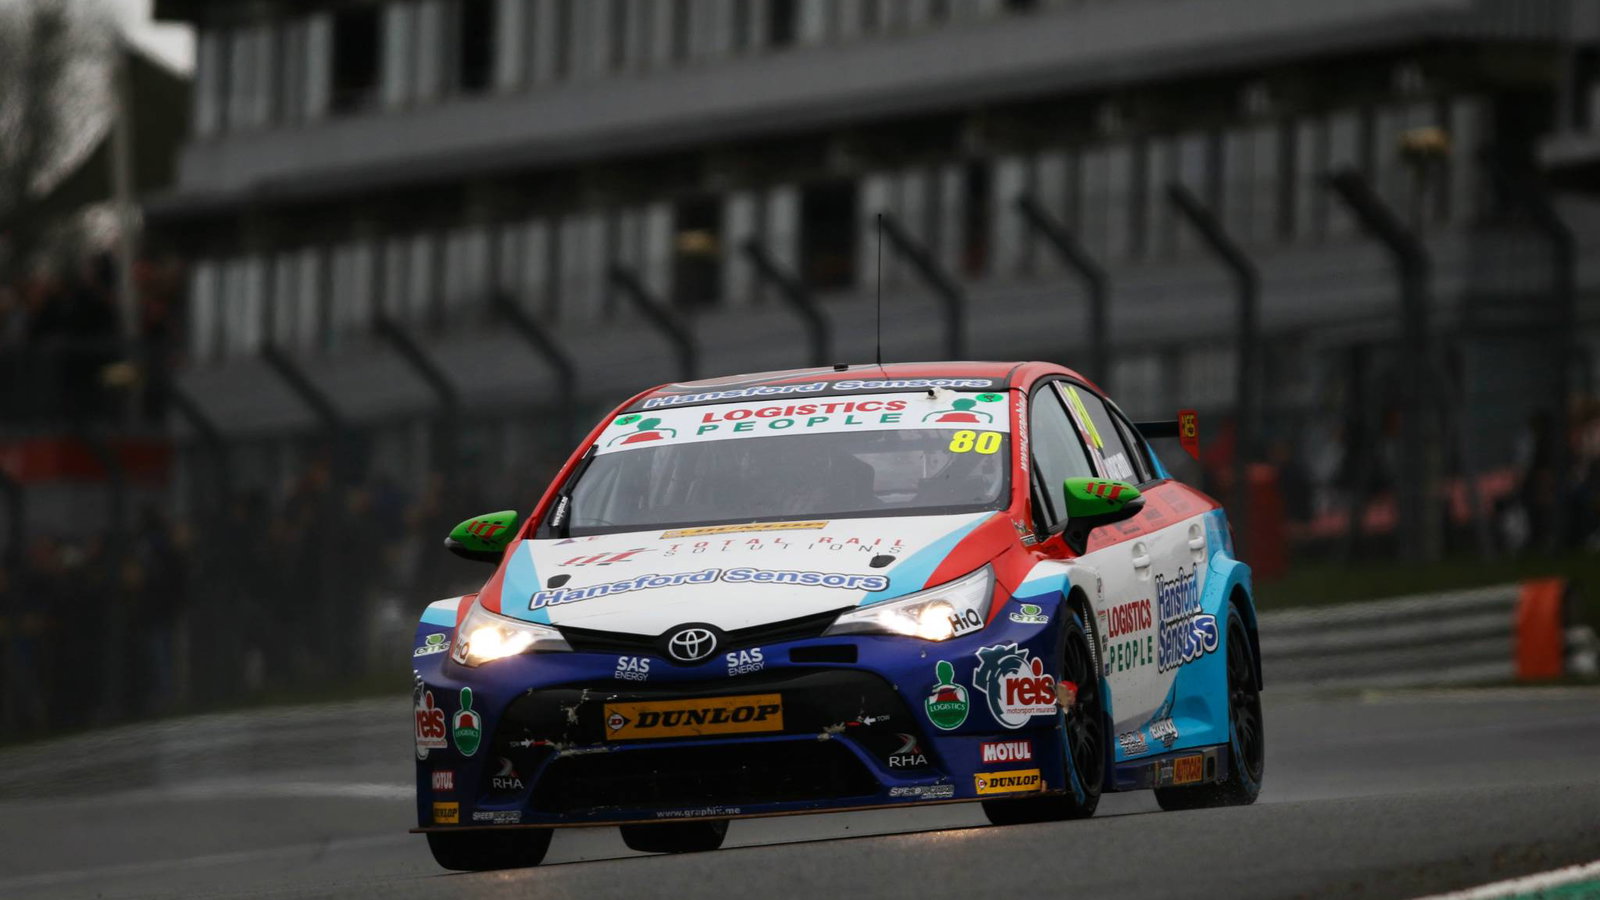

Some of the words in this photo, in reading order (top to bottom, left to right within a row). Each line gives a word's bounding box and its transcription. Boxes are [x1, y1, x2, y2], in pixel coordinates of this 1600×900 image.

[643, 381, 827, 408] Hansford
[833, 378, 992, 393] Sensors
[702, 400, 907, 424] LOGISTICS
[697, 413, 902, 436] PEOPLE
[948, 430, 1002, 455] 80
[663, 543, 903, 557] SOLUTIONS
[669, 537, 787, 551] TOTAL
[818, 536, 906, 547] RAIL
[529, 569, 720, 610] Hansford
[723, 567, 890, 592] Sensors
[1155, 563, 1202, 620] Hansford
[948, 608, 982, 632] HiQ
[1107, 598, 1152, 638] LOGISTICS
[1110, 635, 1153, 673] PEOPLE
[1158, 614, 1218, 673] Sensors
[617, 656, 650, 673] SAS
[727, 648, 764, 668] SAS
[728, 662, 766, 677] ENERGY
[614, 671, 649, 681] ENERGY
[1006, 658, 1056, 705] reis
[634, 704, 780, 728] DUNLOP
[929, 701, 967, 712] LOGISTICS
[889, 754, 928, 767] RHA
[983, 742, 1032, 762] MOTUL
[493, 778, 524, 789] RHA
[989, 775, 1039, 788] DUNLOP
